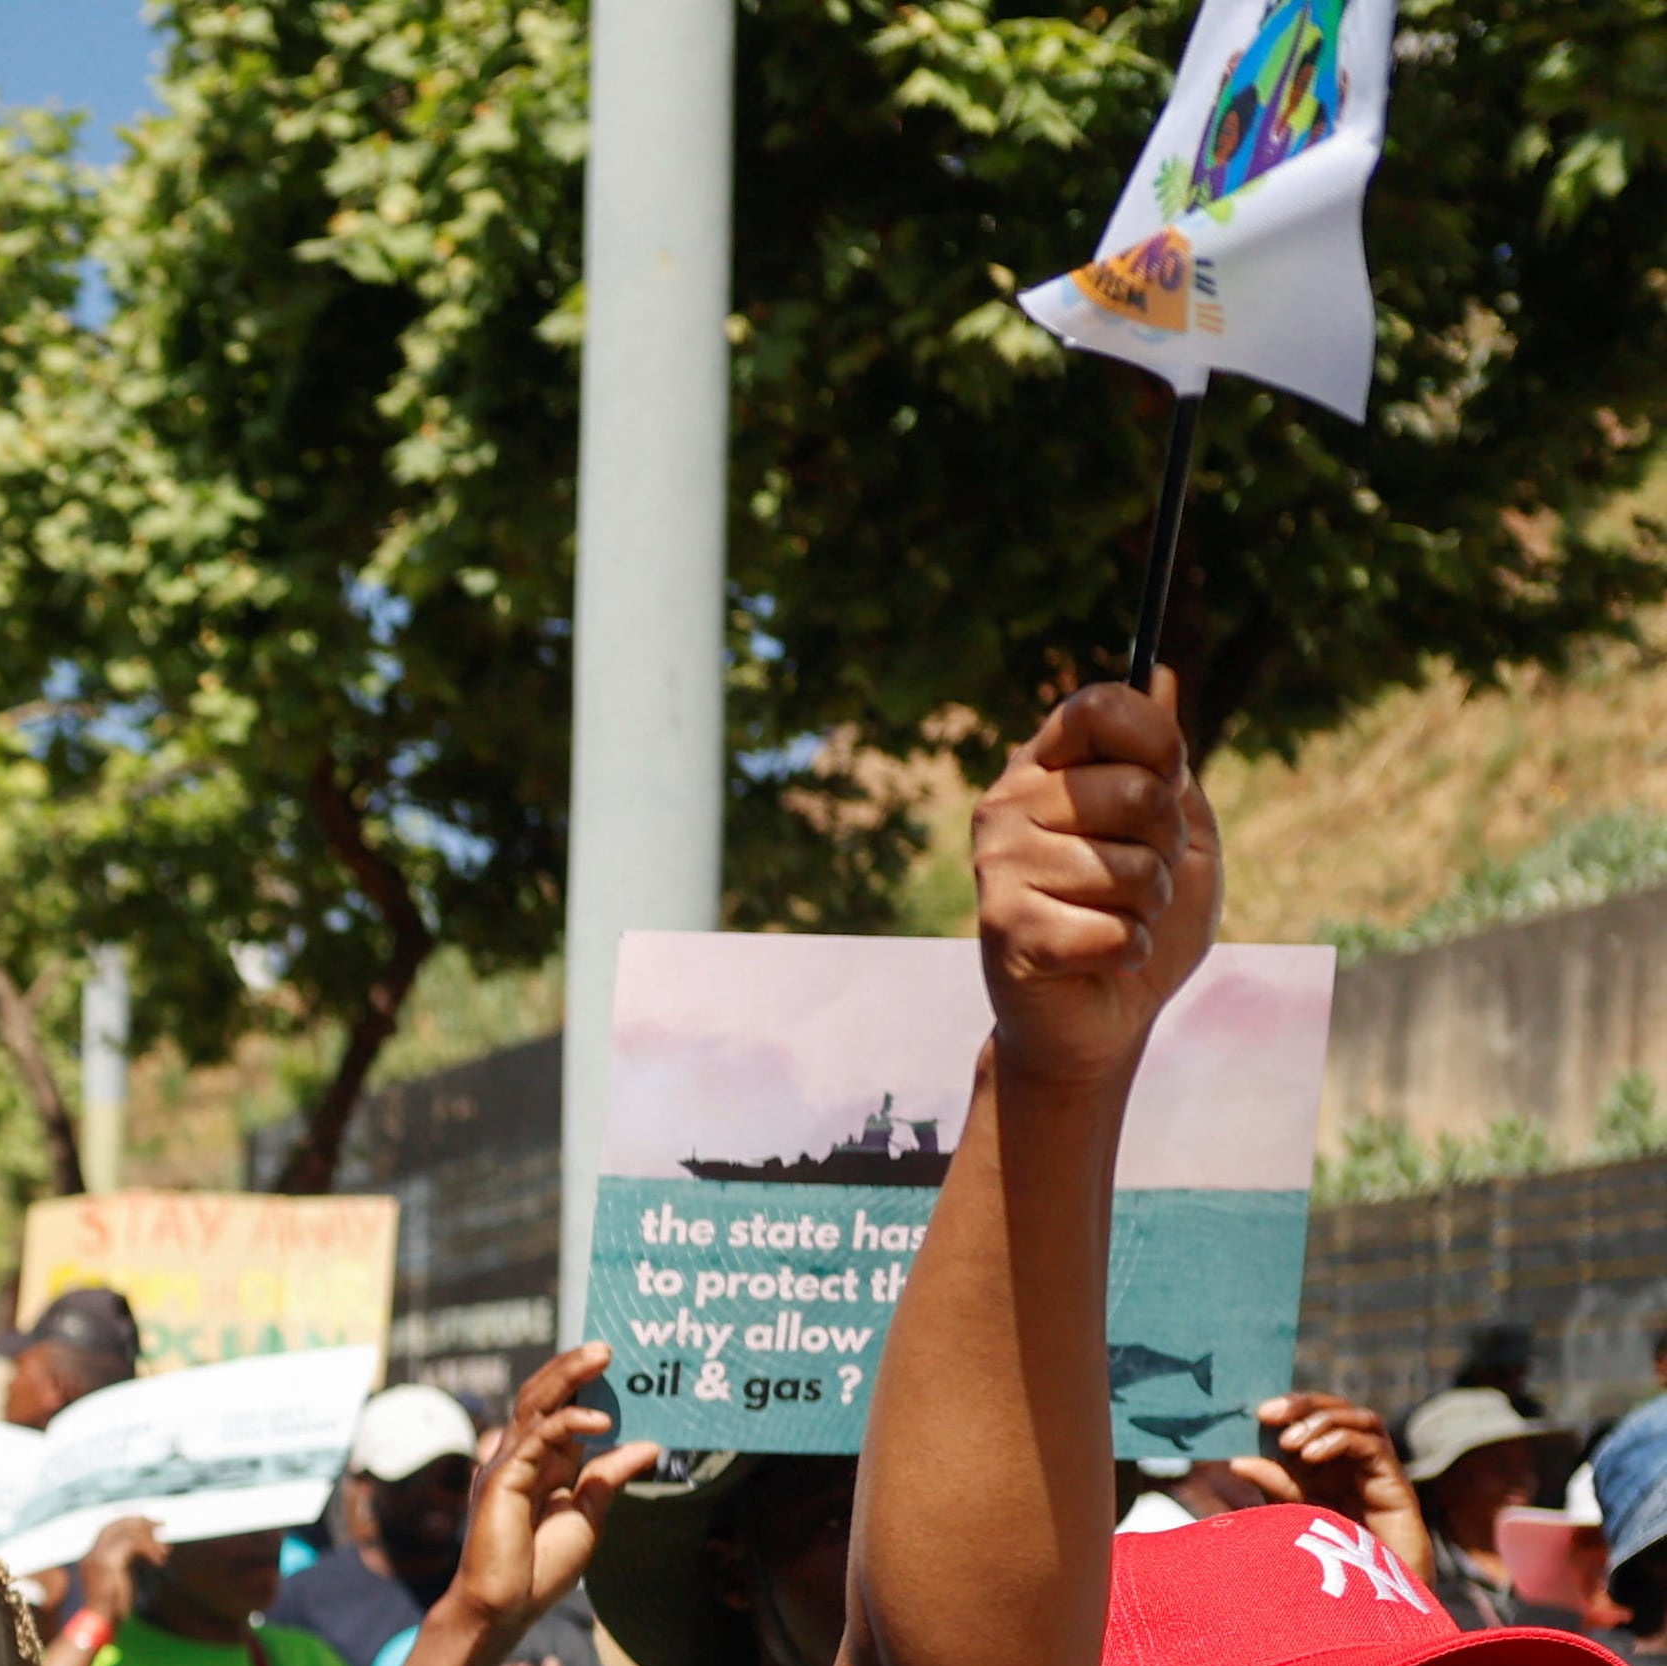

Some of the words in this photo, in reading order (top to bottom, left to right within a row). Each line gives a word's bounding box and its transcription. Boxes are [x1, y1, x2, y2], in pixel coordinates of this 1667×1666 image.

[640, 1202, 716, 1245] the
[727, 1213, 841, 1250] state
[635, 1260, 683, 1297] to
[695, 1265, 859, 1309] protect
[630, 1307, 735, 1360] why
[744, 1311, 873, 1354] allow
[626, 1360, 681, 1397] oil
[693, 1360, 731, 1402] &
[743, 1375, 823, 1411] gas
